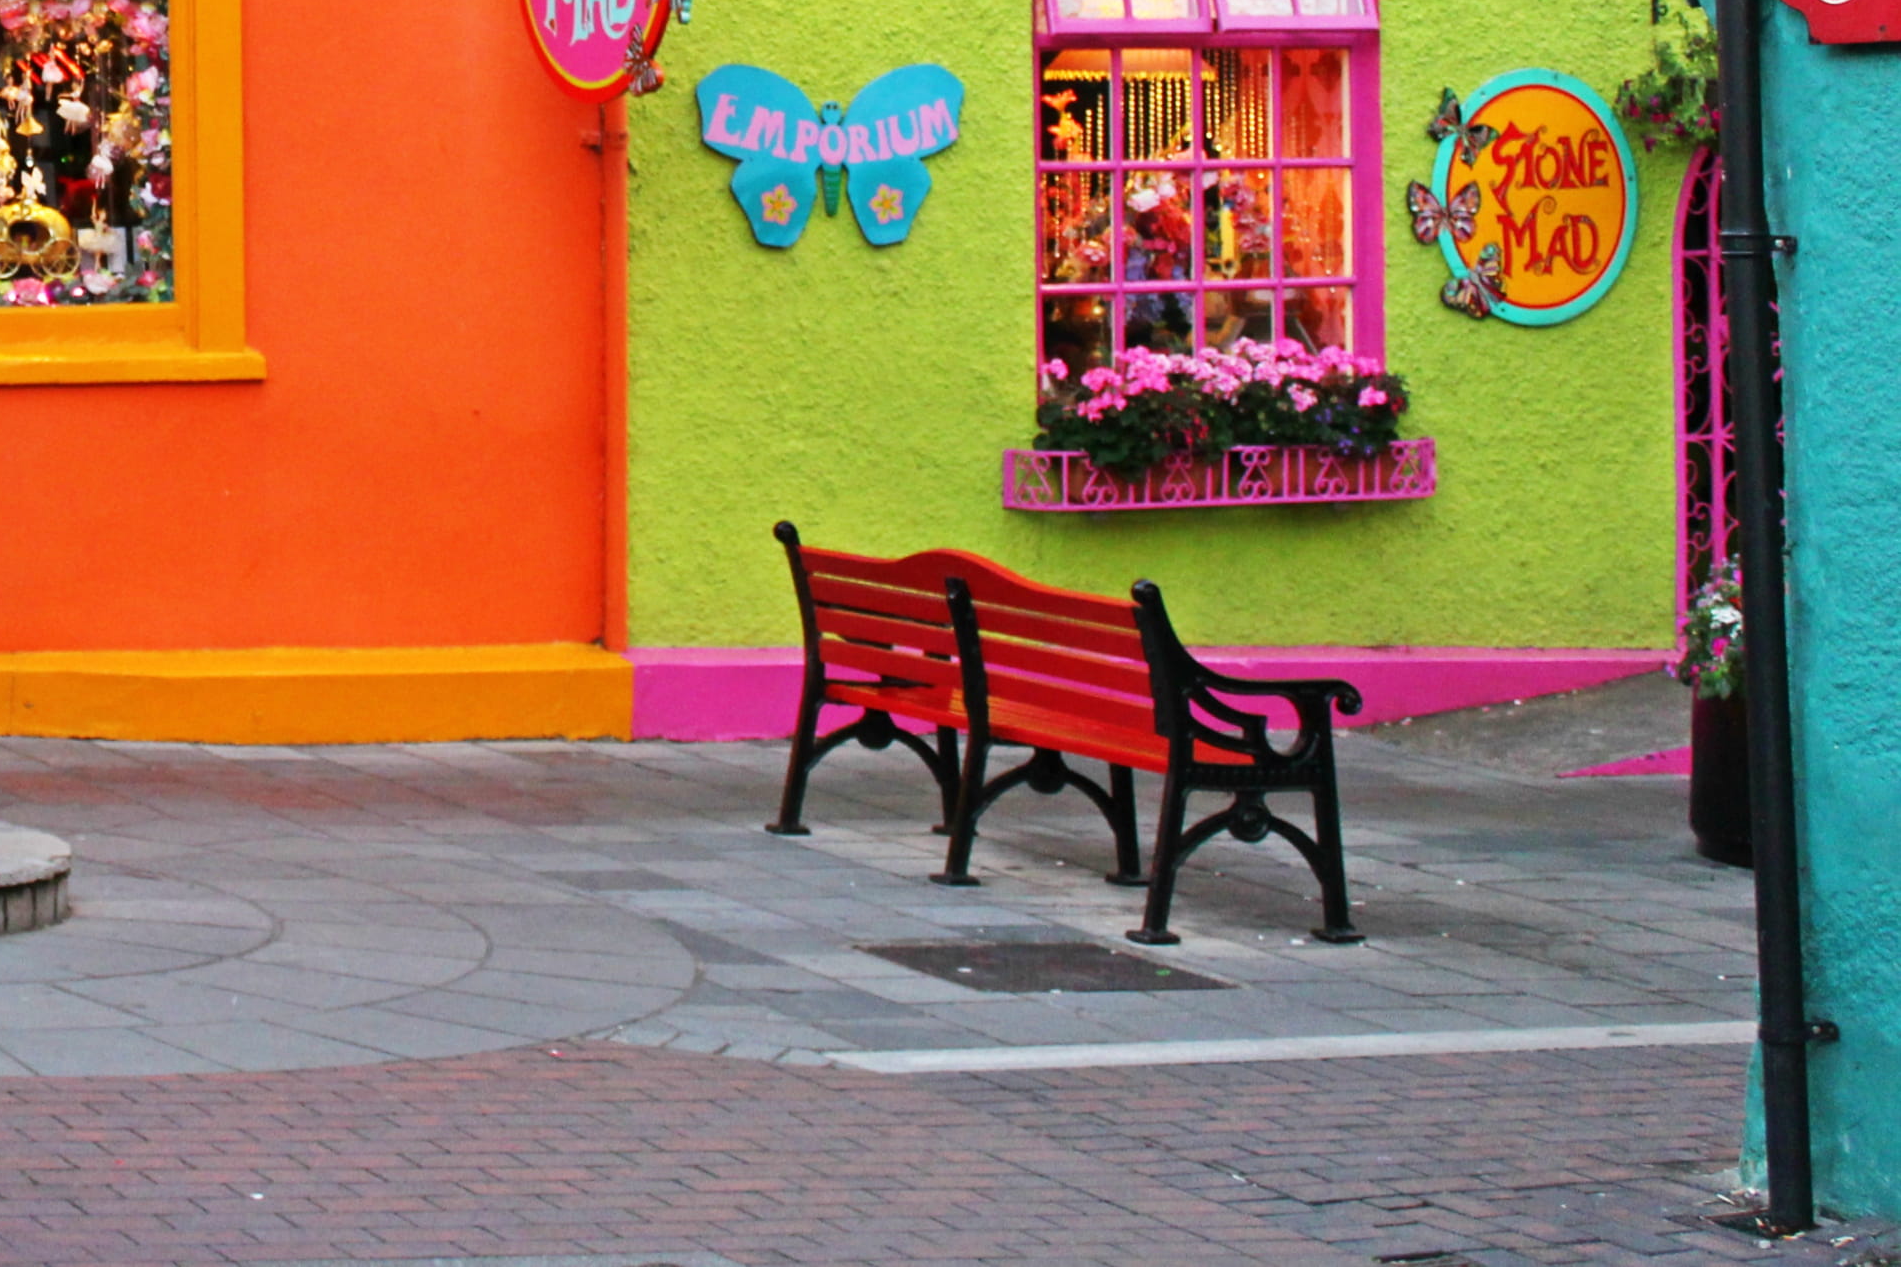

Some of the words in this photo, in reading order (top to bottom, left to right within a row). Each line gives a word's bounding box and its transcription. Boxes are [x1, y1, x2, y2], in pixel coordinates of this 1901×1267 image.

[702, 92, 960, 166] EMPORIUM
[1489, 120, 1611, 217] STONE
[1496, 195, 1602, 278] MAD
